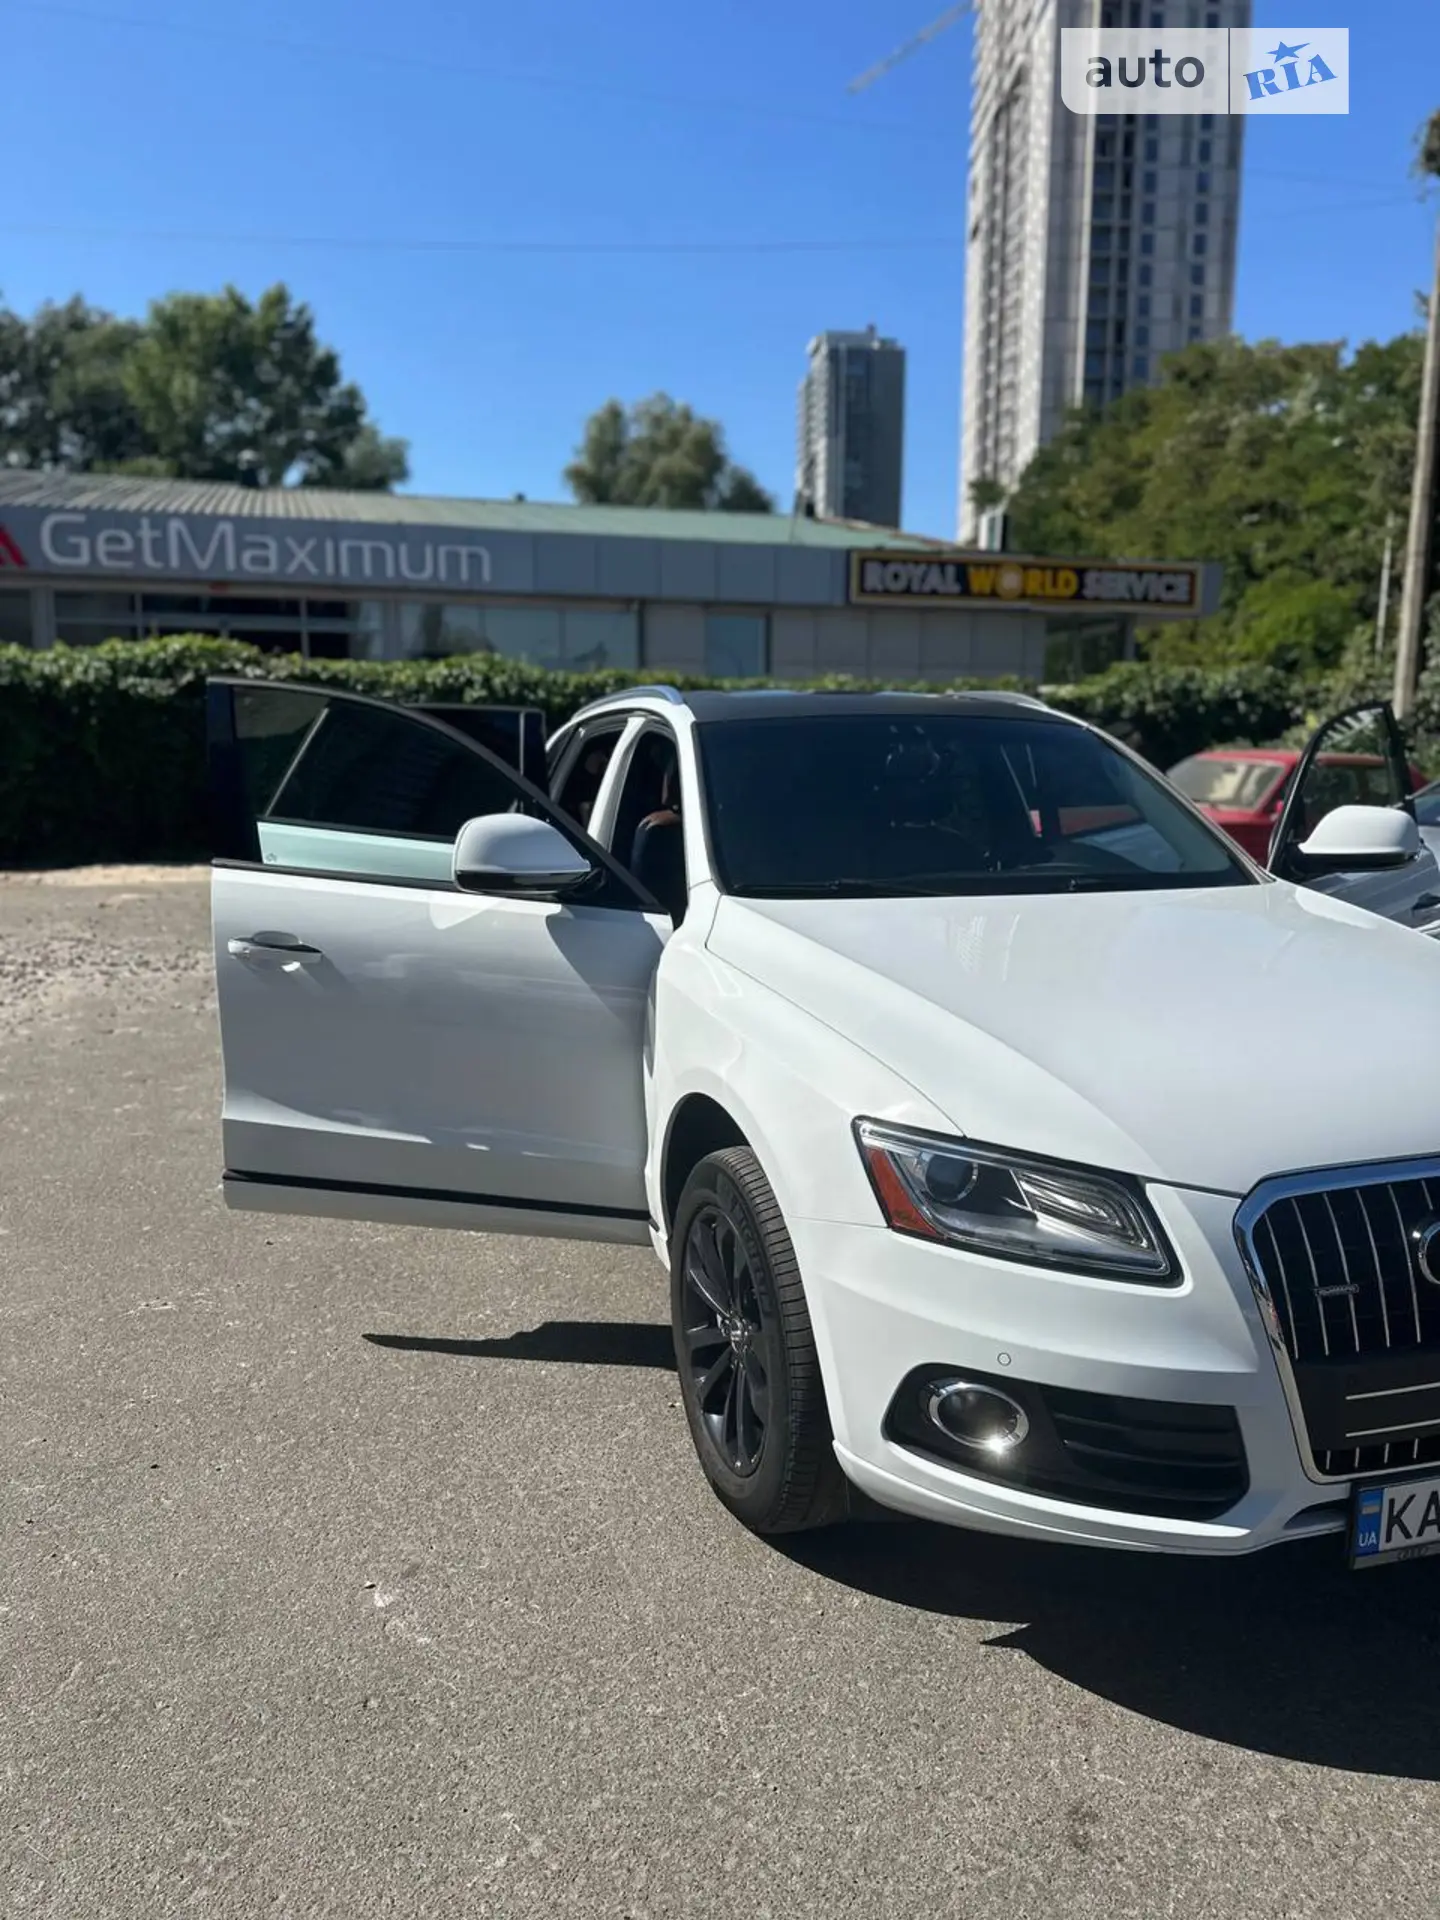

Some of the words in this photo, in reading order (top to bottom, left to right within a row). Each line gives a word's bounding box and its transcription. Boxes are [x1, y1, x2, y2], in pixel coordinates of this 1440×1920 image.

[39, 513, 492, 583] GetMaximum
[863, 560, 961, 594] ROYAL
[967, 563, 1080, 599] WORLD
[1083, 568, 1191, 602] SERVICE
[1358, 1530, 1378, 1548] UA
[1385, 1490, 1440, 1544] KA
